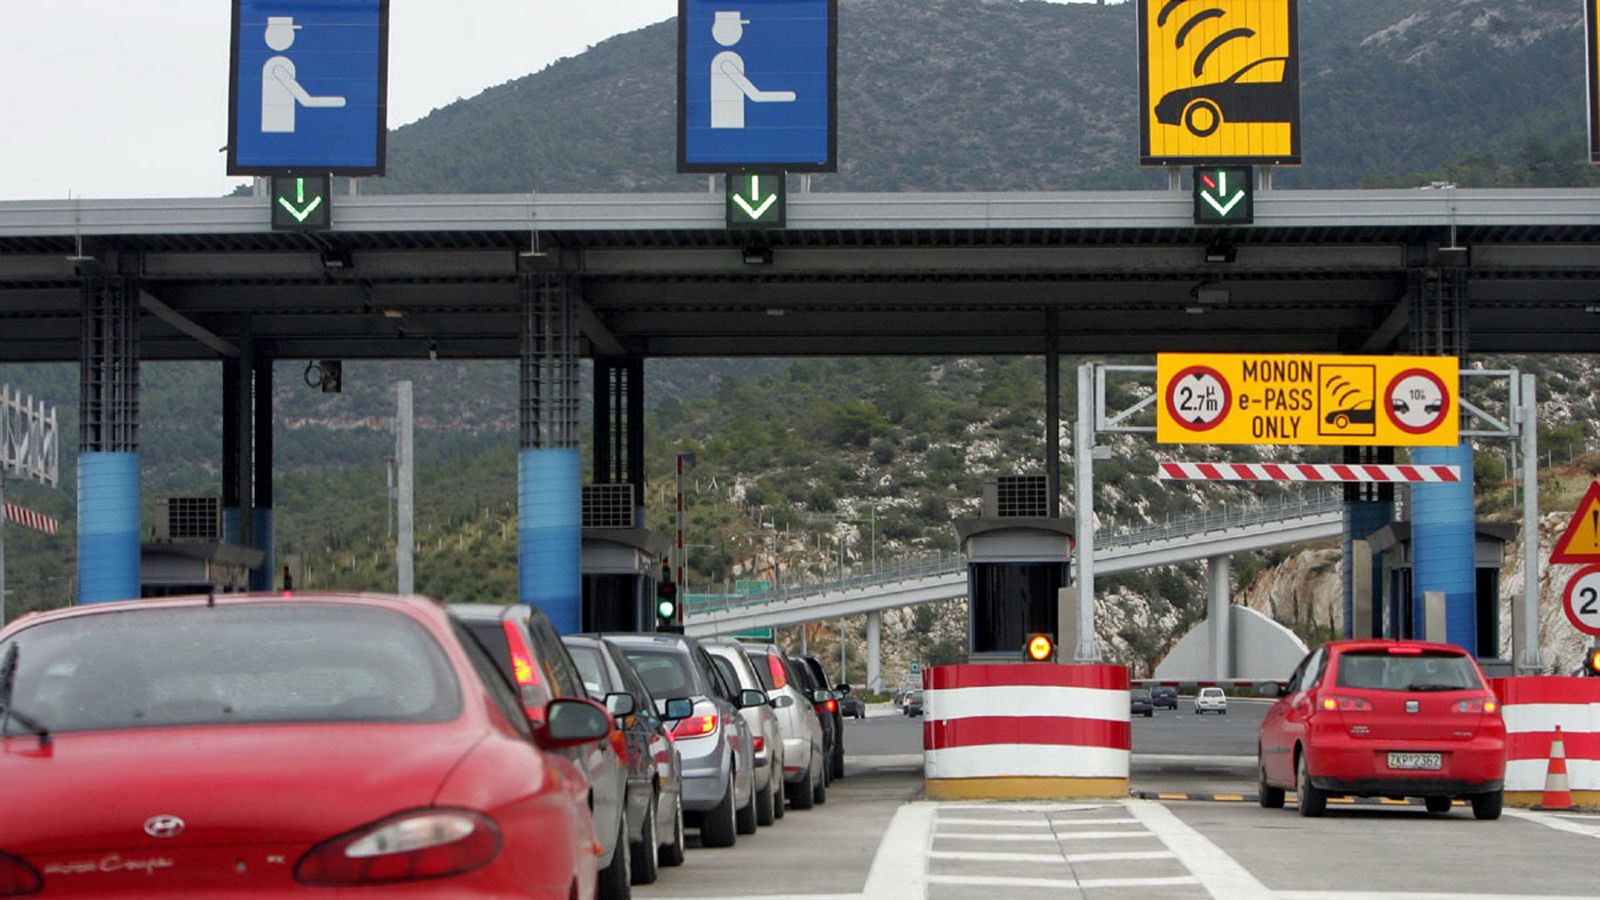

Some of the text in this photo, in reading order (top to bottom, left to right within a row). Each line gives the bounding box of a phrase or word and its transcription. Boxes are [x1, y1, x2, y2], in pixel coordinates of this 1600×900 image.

[1242, 360, 1313, 382] MONON
[1180, 386, 1205, 410] 2.7
[1239, 388, 1313, 411] e-PASS
[1252, 416, 1302, 438] ONLY
